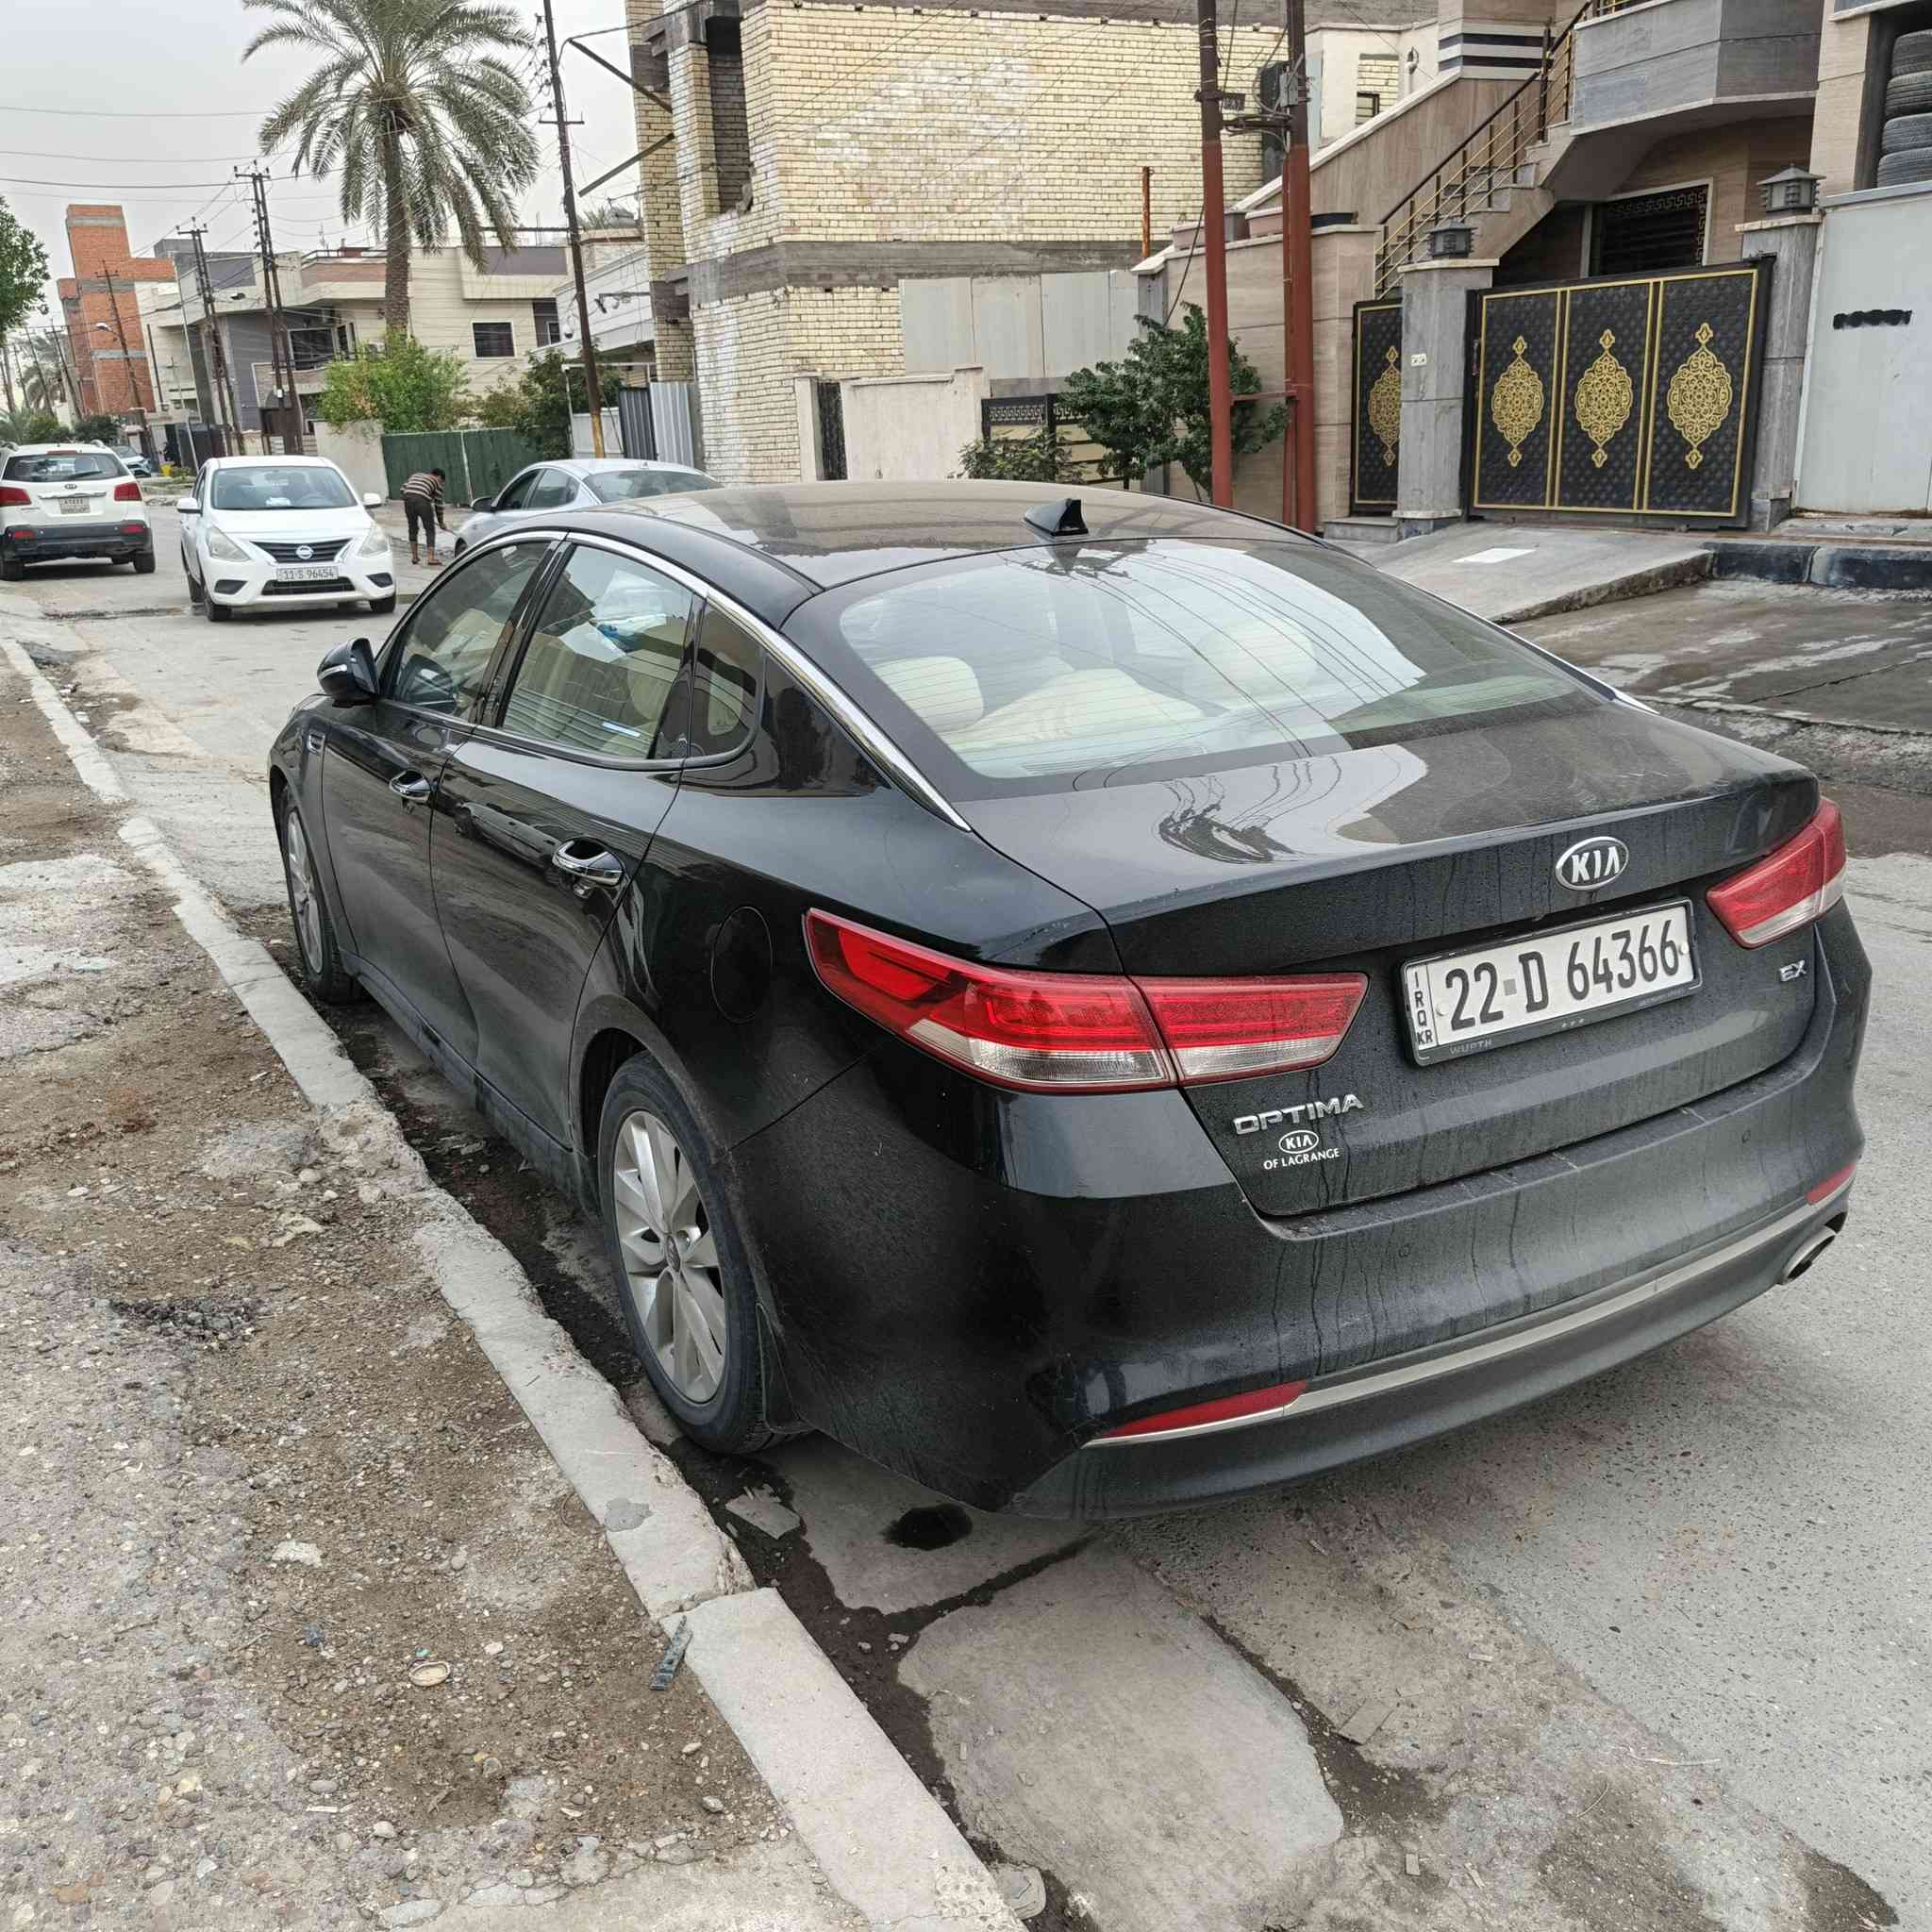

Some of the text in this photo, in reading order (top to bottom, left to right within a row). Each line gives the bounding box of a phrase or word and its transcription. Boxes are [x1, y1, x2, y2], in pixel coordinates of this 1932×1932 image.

[1571, 846, 1620, 883] KIA
[1445, 919, 1679, 1031] 22 D 64366
[1779, 959, 1807, 982] EX
[1416, 1029, 1434, 1045] KR
[1232, 1093, 1365, 1135] OPTIMA
[1285, 1134, 1313, 1150] KIA
[1263, 1148, 1341, 1170] OF LAGRANGE
